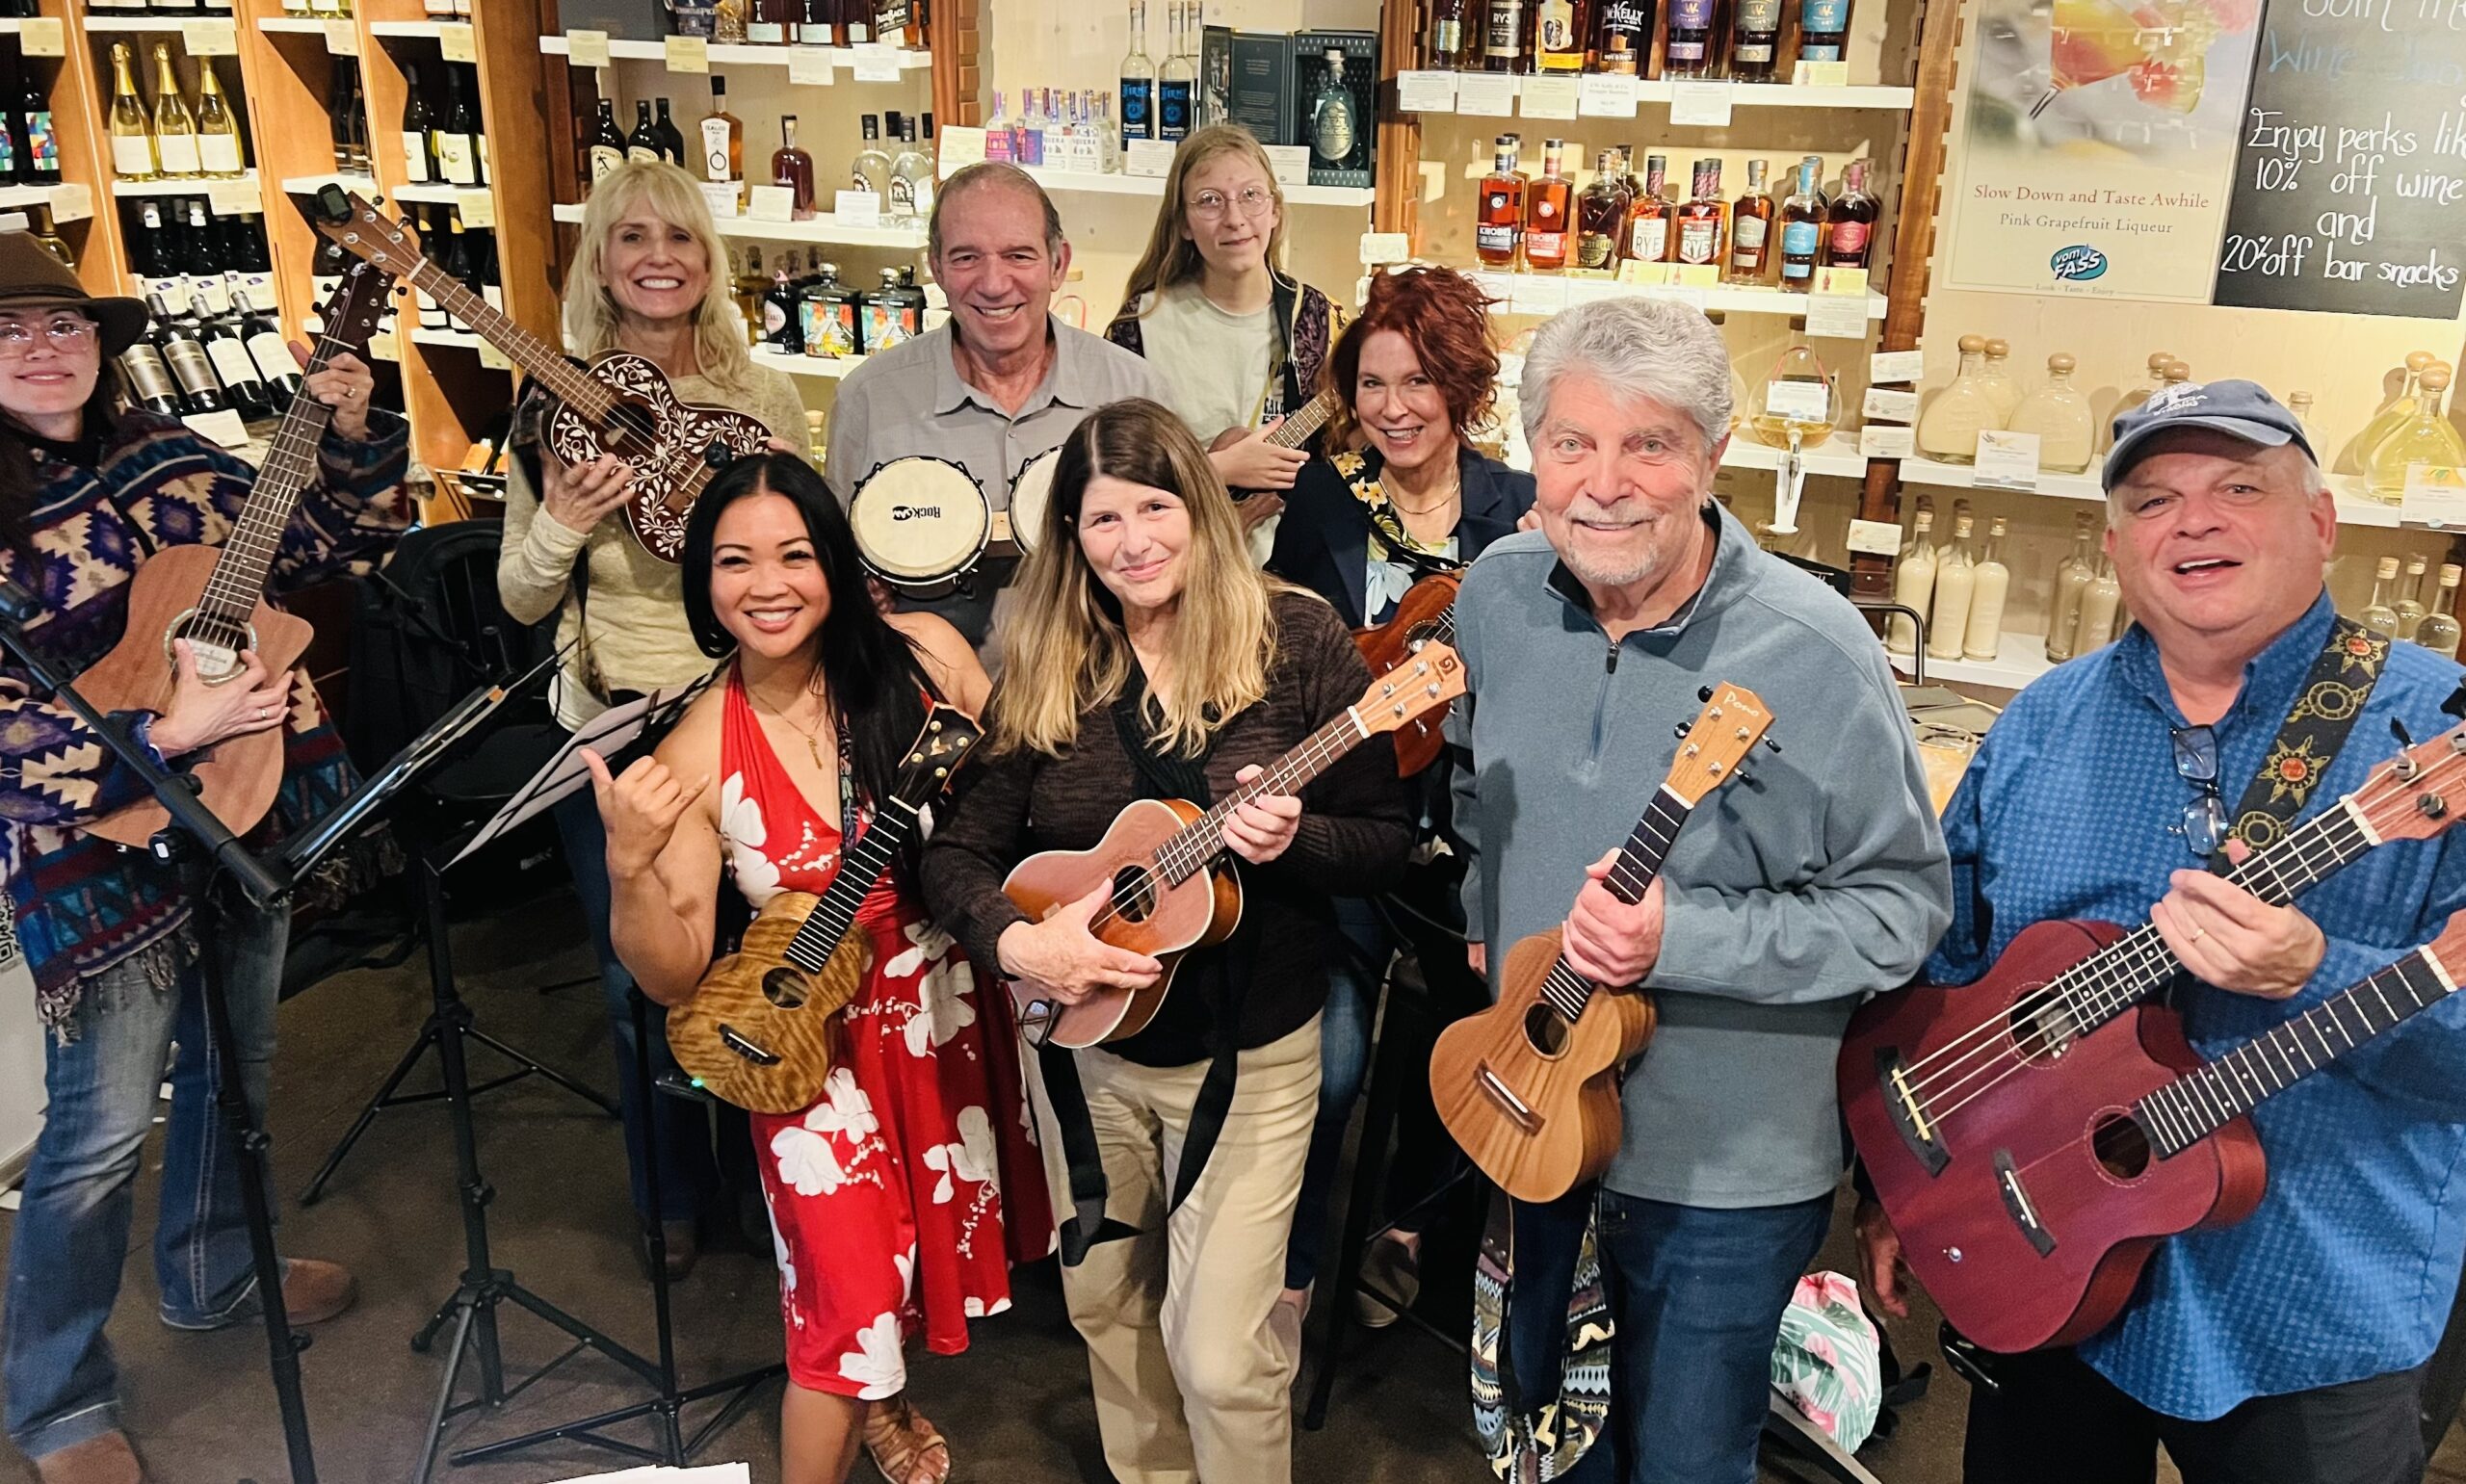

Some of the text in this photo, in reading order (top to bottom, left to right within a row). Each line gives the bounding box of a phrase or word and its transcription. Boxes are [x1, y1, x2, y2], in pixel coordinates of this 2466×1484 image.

[2247, 107, 2326, 163] Enjoy
[2336, 111, 2418, 164] perks
[2255, 153, 2464, 205] 10% off wine
[1974, 185, 2210, 209] Slow Down and Taste Awhile
[2000, 213, 2174, 236] Pink Grapefruit Liqueur
[2316, 195, 2378, 246] and
[1637, 235, 1662, 256] RYE
[1685, 240, 1710, 261] RYE
[2055, 247, 2082, 264] vom
[2054, 251, 2102, 280] FASS
[2323, 240, 2371, 281] bar
[2376, 248, 2460, 292] snacks
[1723, 690, 1760, 717] Pono
